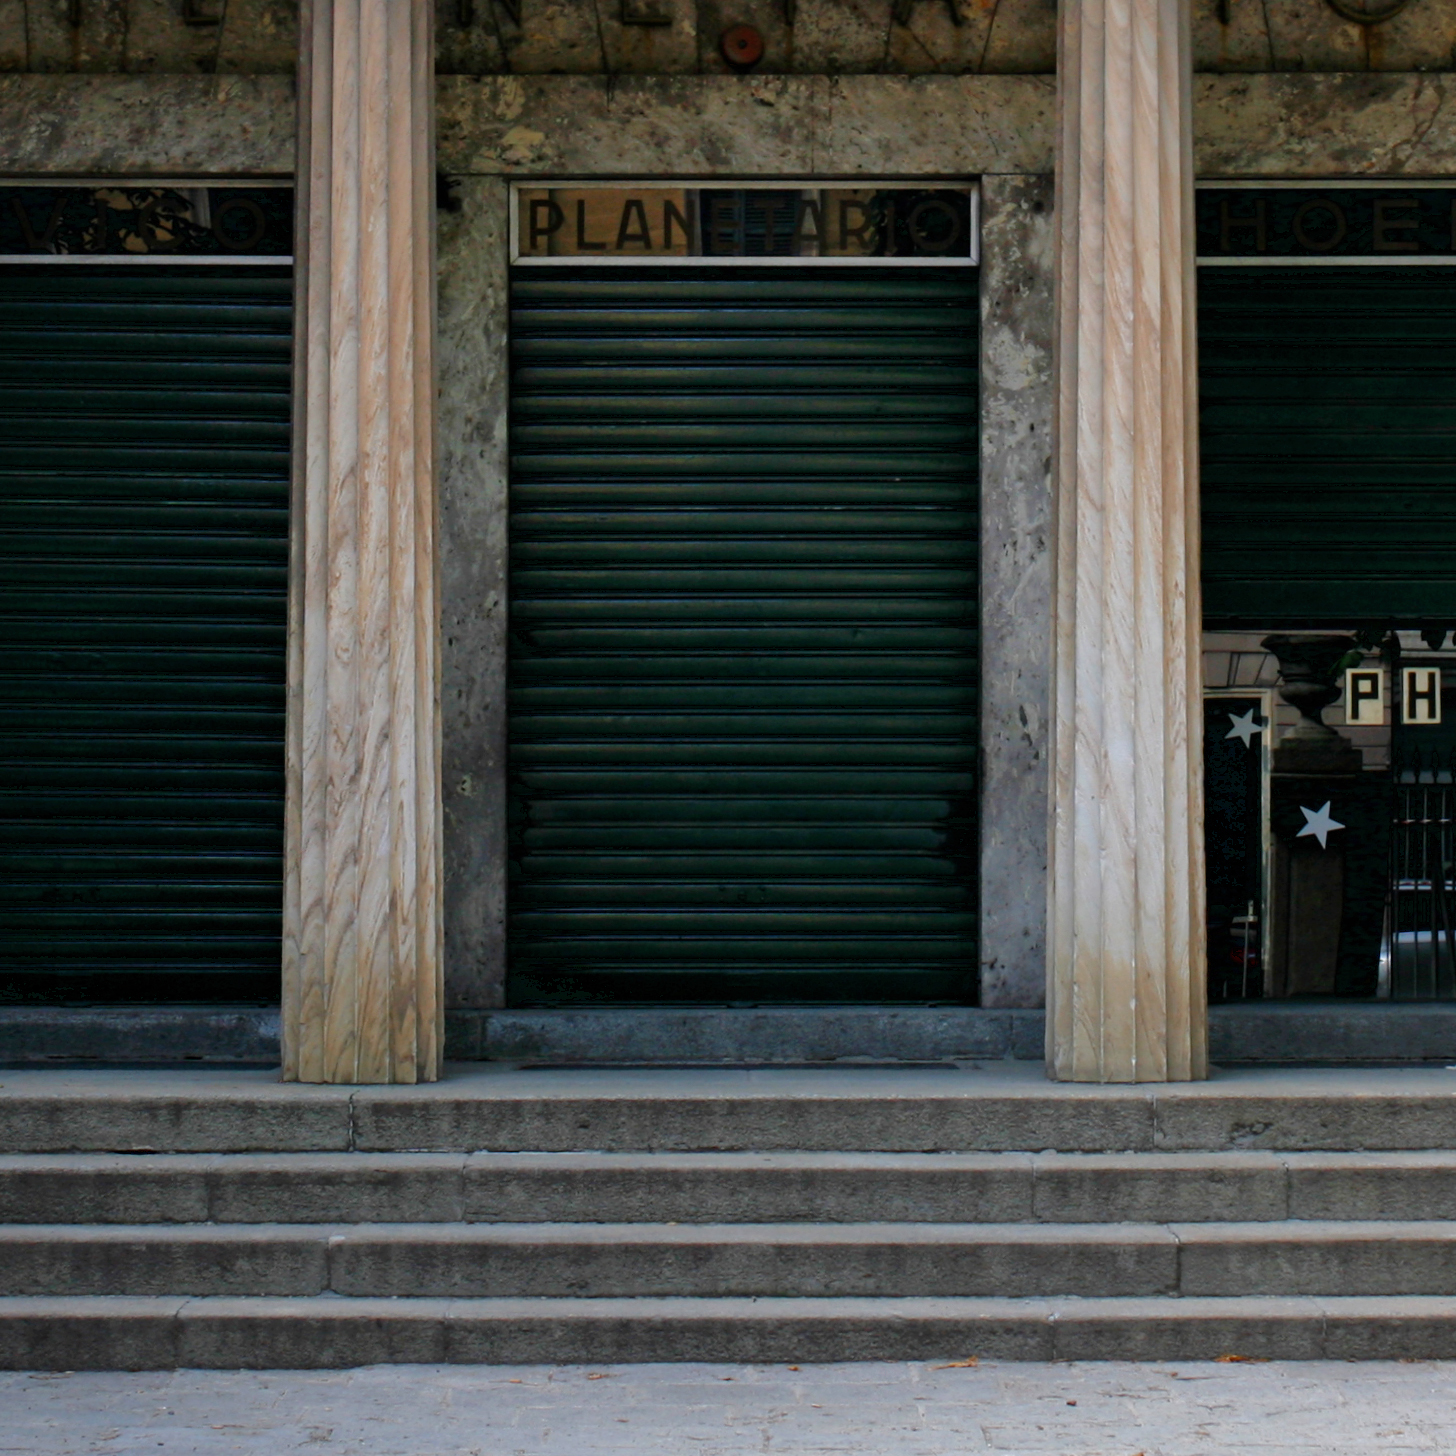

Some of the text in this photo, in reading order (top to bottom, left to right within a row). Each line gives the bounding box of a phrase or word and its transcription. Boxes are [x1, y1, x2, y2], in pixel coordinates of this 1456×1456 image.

[528, 199, 961, 252] PLANETARIO
[1351, 672, 1436, 720] P H
